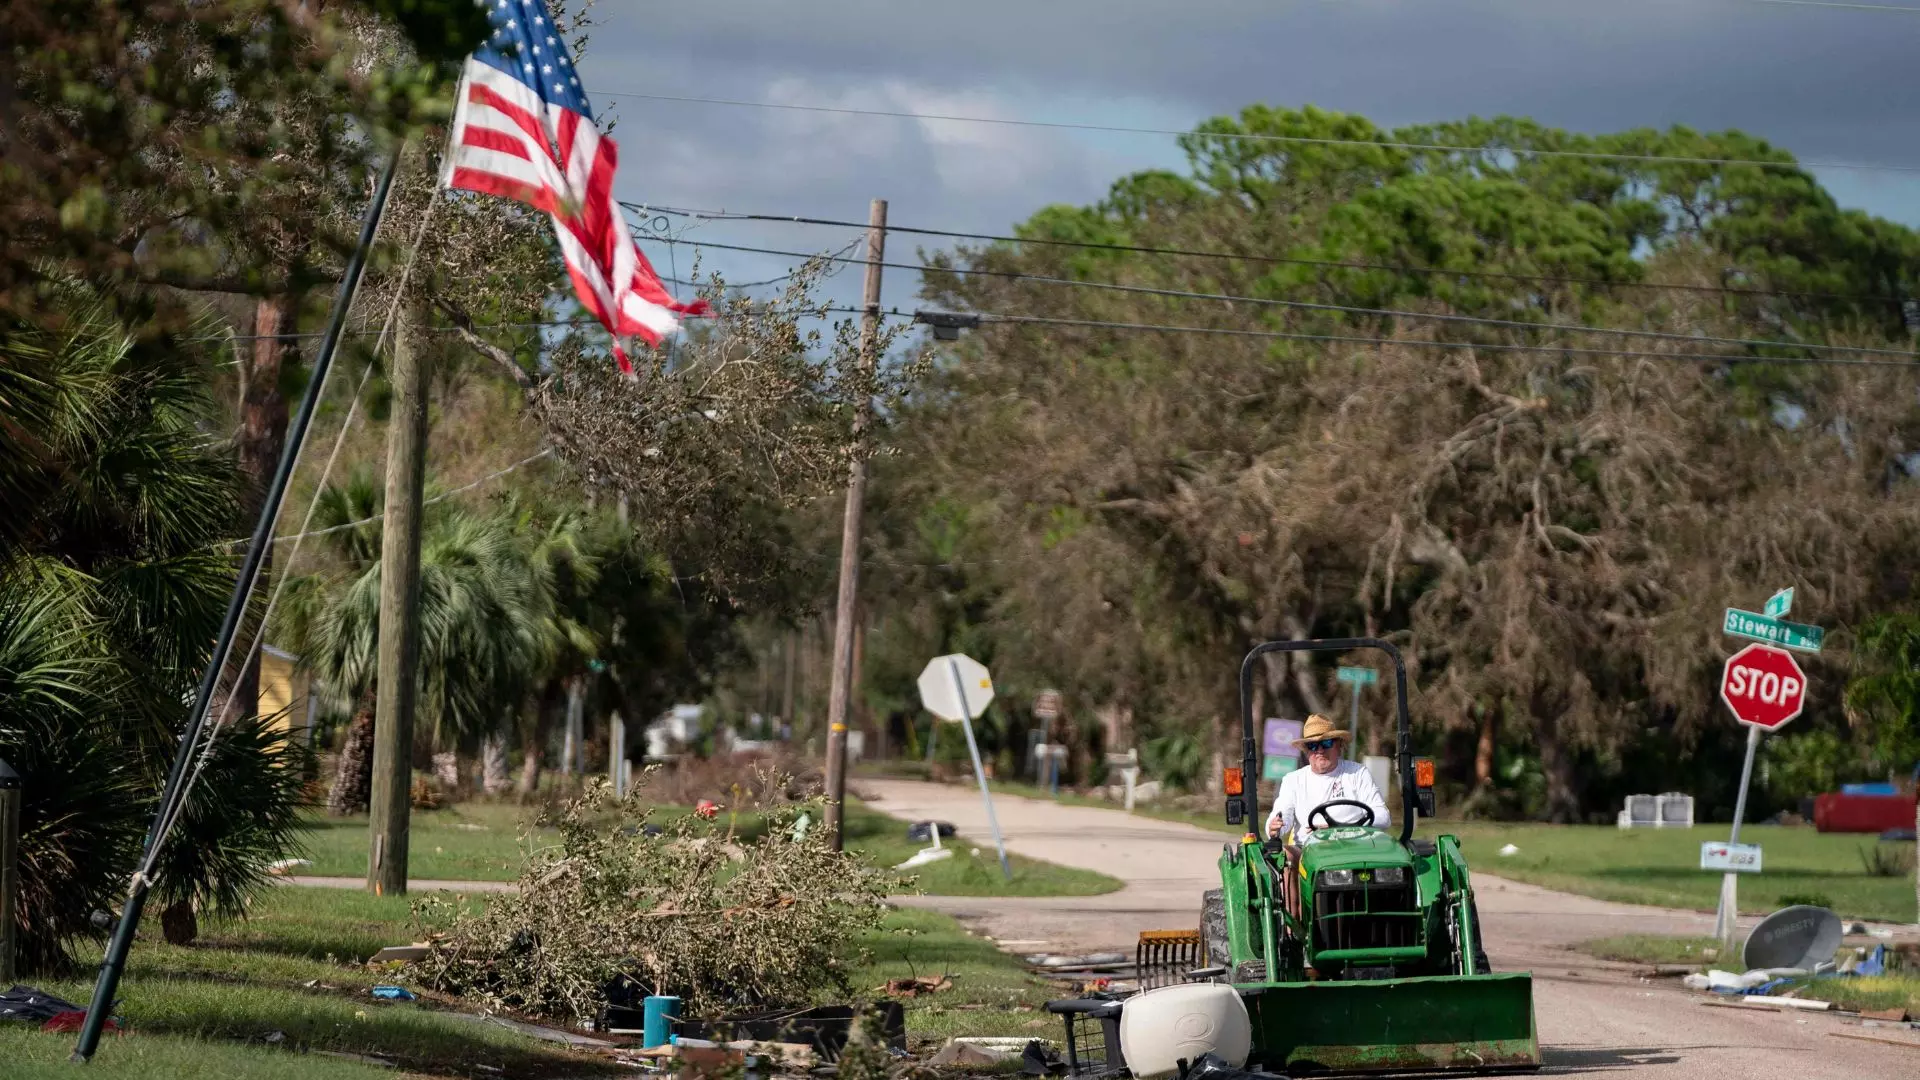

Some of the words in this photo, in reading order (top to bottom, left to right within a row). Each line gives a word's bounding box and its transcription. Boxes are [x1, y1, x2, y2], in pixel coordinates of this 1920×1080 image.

[1728, 613, 1791, 642] Stewart
[1728, 664, 1800, 707] STOP
[1774, 917, 1815, 938] DIRECTV
